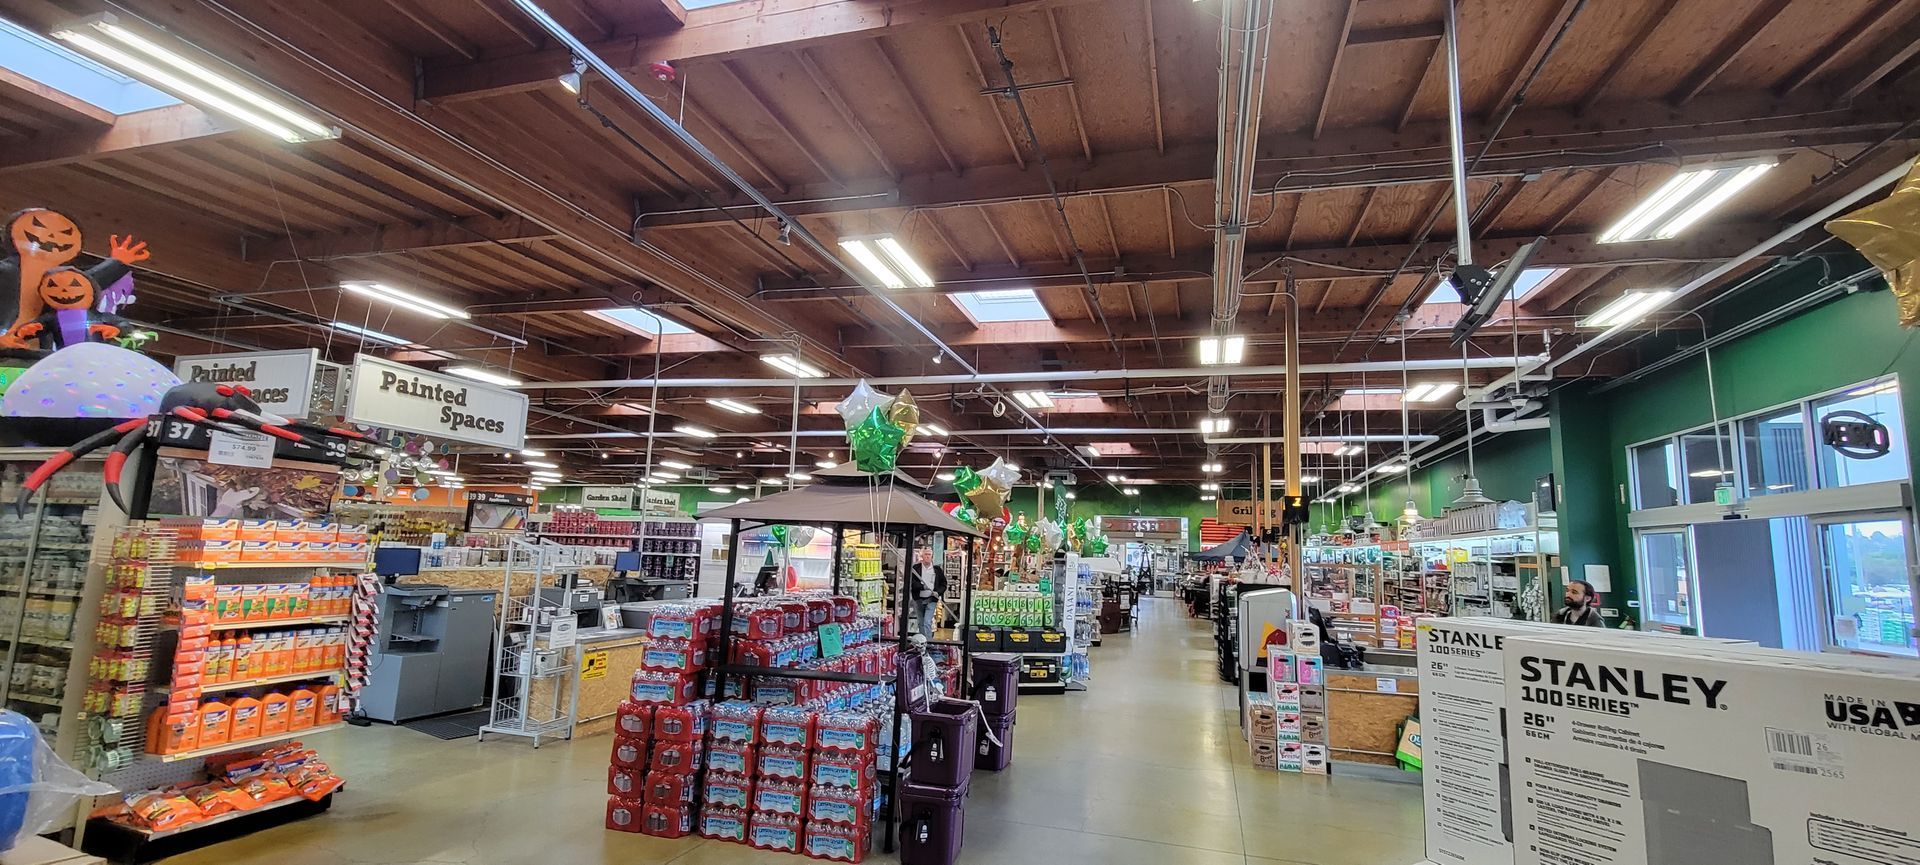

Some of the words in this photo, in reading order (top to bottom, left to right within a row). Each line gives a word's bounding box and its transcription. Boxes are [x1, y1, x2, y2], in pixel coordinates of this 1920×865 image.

[190, 361, 256, 383] Painted
[251, 387, 288, 402] aces
[380, 370, 467, 407] Painted
[441, 406, 505, 434] Spaces
[146, 421, 161, 438] 37
[169, 422, 195, 440] 37
[646, 496, 663, 504] arden
[1232, 507, 1276, 518] Grilg
[1428, 629, 1504, 650] STANLE
[1429, 645, 1449, 654] 100
[1522, 686, 1563, 706] 100
[1566, 693, 1630, 715] SERIES
[1824, 694, 1863, 704] MADE
[1524, 712, 1555, 728] 26"
[1825, 701, 1899, 730] USA
[1826, 721, 1857, 732] WITH
[1860, 727, 1907, 740] GLOBAL
[1821, 768, 1845, 779] 2565
